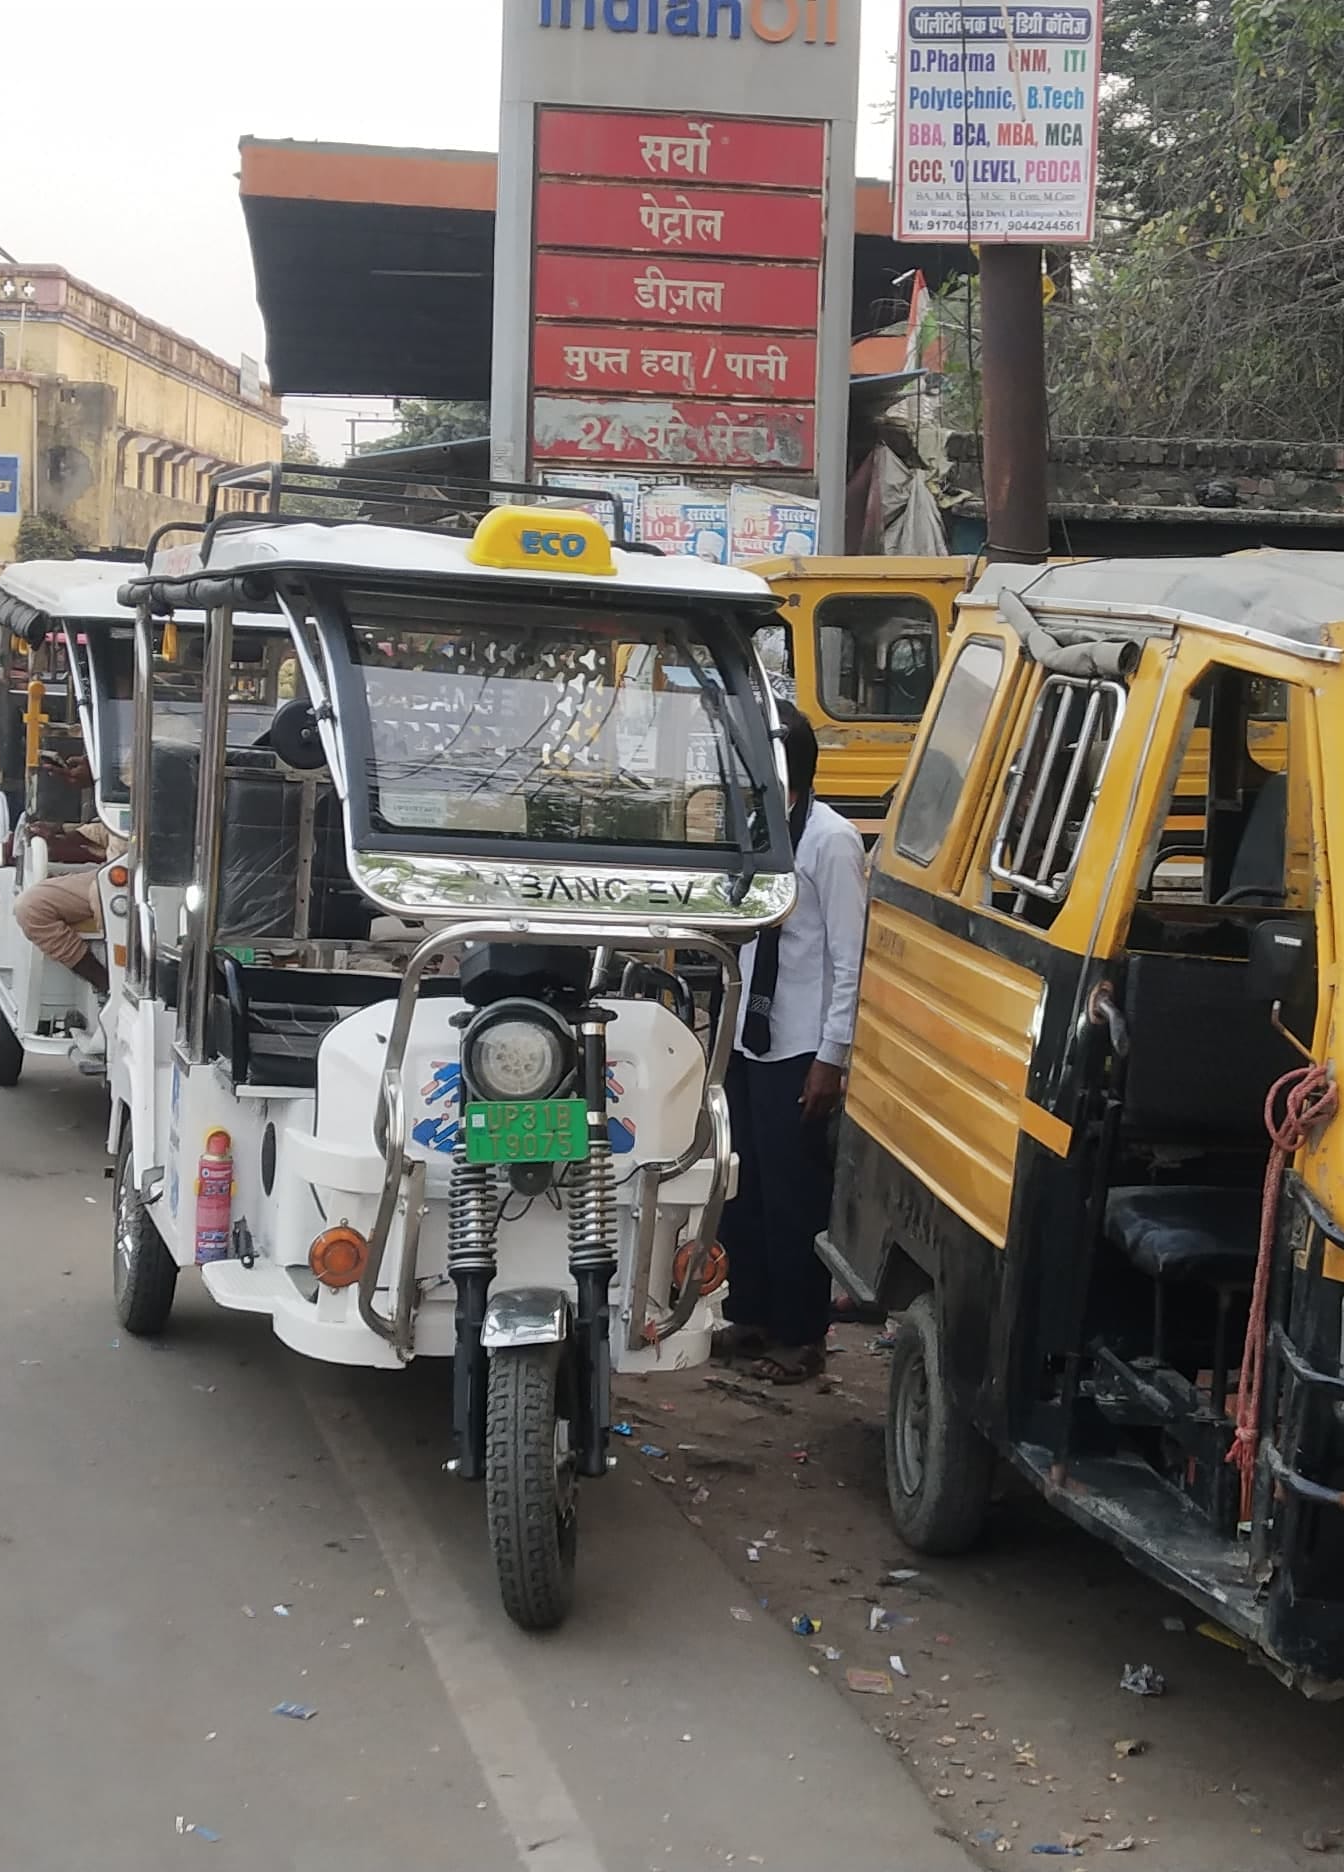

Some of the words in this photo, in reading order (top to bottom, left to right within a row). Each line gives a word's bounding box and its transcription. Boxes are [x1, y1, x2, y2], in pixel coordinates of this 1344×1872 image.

[1045, 11, 1088, 35] कॉलेज
[910, 49, 995, 72] D.Pharma
[1064, 49, 1086, 73] ITI
[910, 86, 1016, 111] Polytechnic,
[1027, 86, 1084, 110] B.Tech
[639, 123, 713, 174] सर्वो
[909, 123, 946, 148] BBA,
[953, 123, 991, 148] BCA,
[997, 123, 1038, 148] MBA,
[1045, 123, 1083, 147] MCA
[909, 159, 946, 184] CCC,
[973, 160, 1020, 185] LEVEL,
[1025, 160, 1081, 184] PGDCA
[640, 193, 724, 245] पेट्रोल
[641, 349, 693, 377] हवा
[725, 345, 788, 381] पानी
[579, 416, 625, 451] 24
[521, 530, 586, 557] ECO
[488, 1132, 573, 1158] T9075
